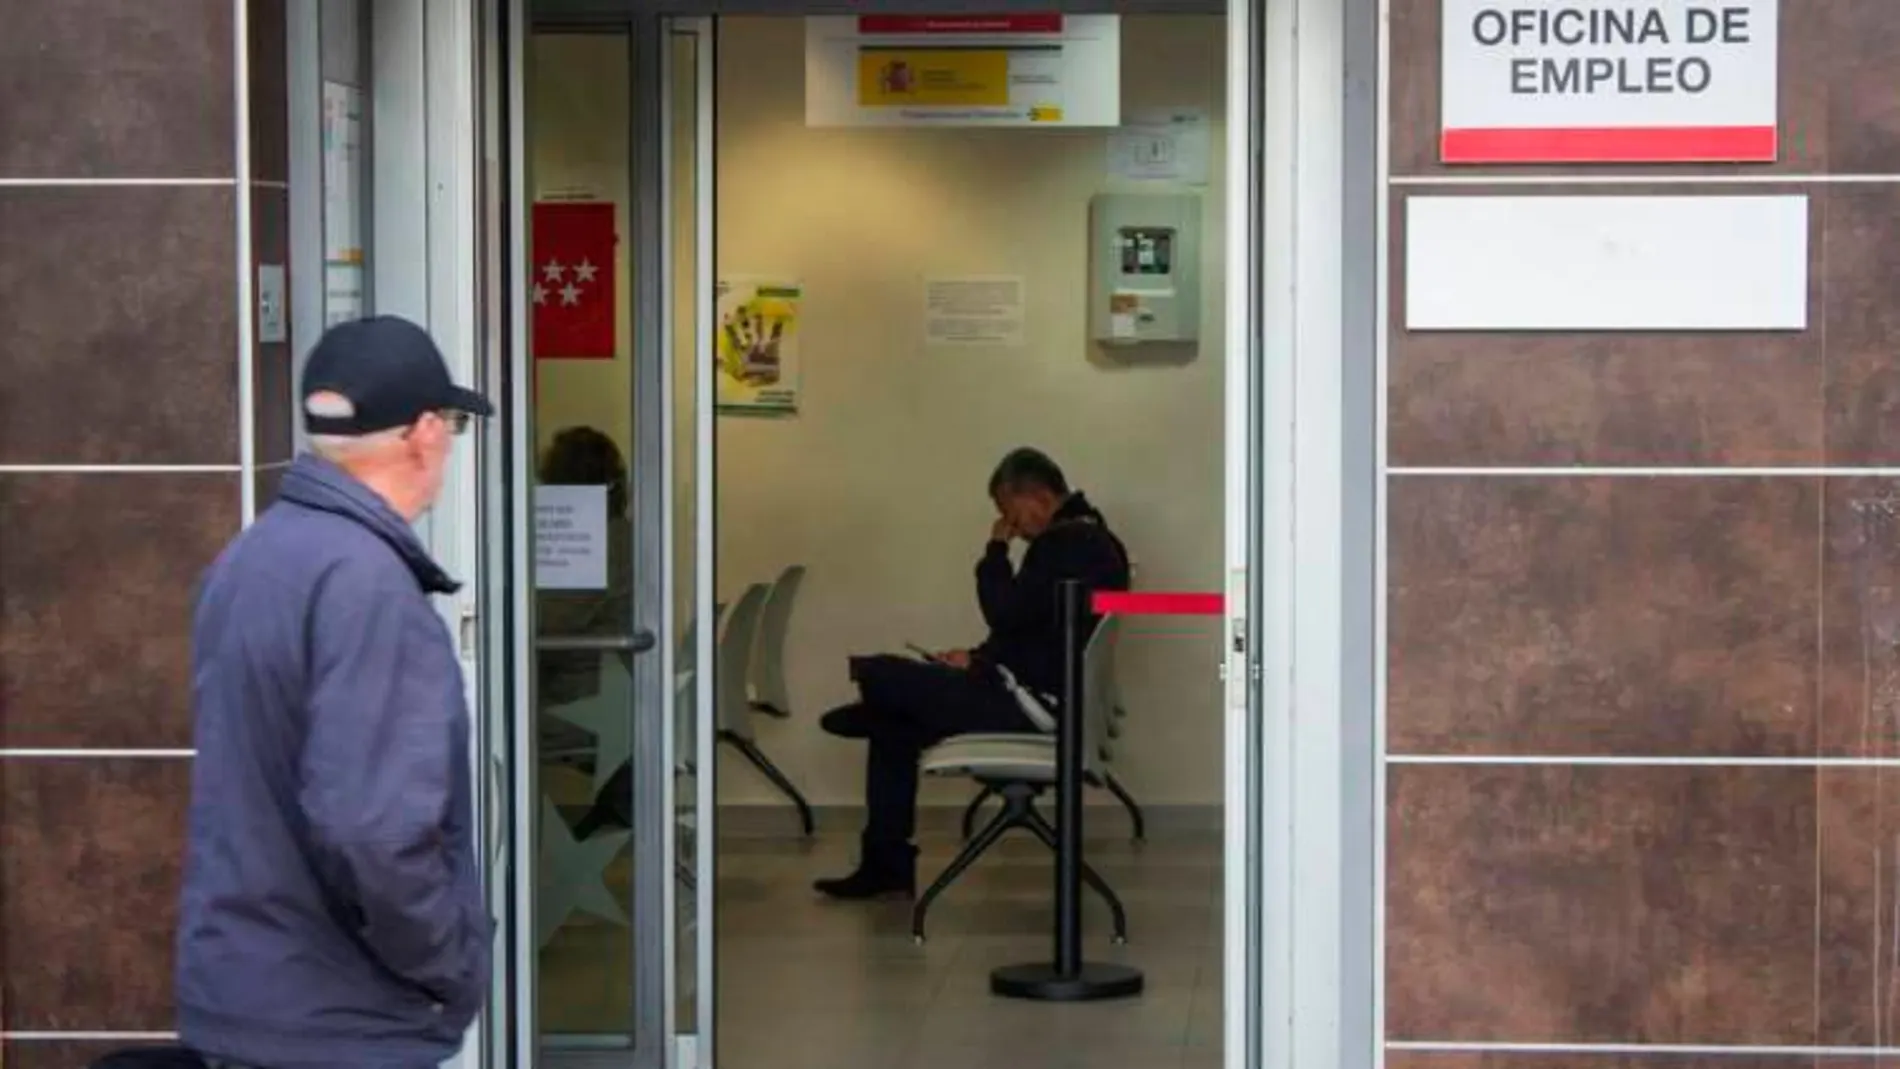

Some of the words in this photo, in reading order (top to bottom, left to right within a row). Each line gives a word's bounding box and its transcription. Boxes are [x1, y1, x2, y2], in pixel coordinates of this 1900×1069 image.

[1472, 7, 1670, 46] OFICINA
[1686, 7, 1750, 44] DE
[1511, 57, 1711, 93] EMPLEO
